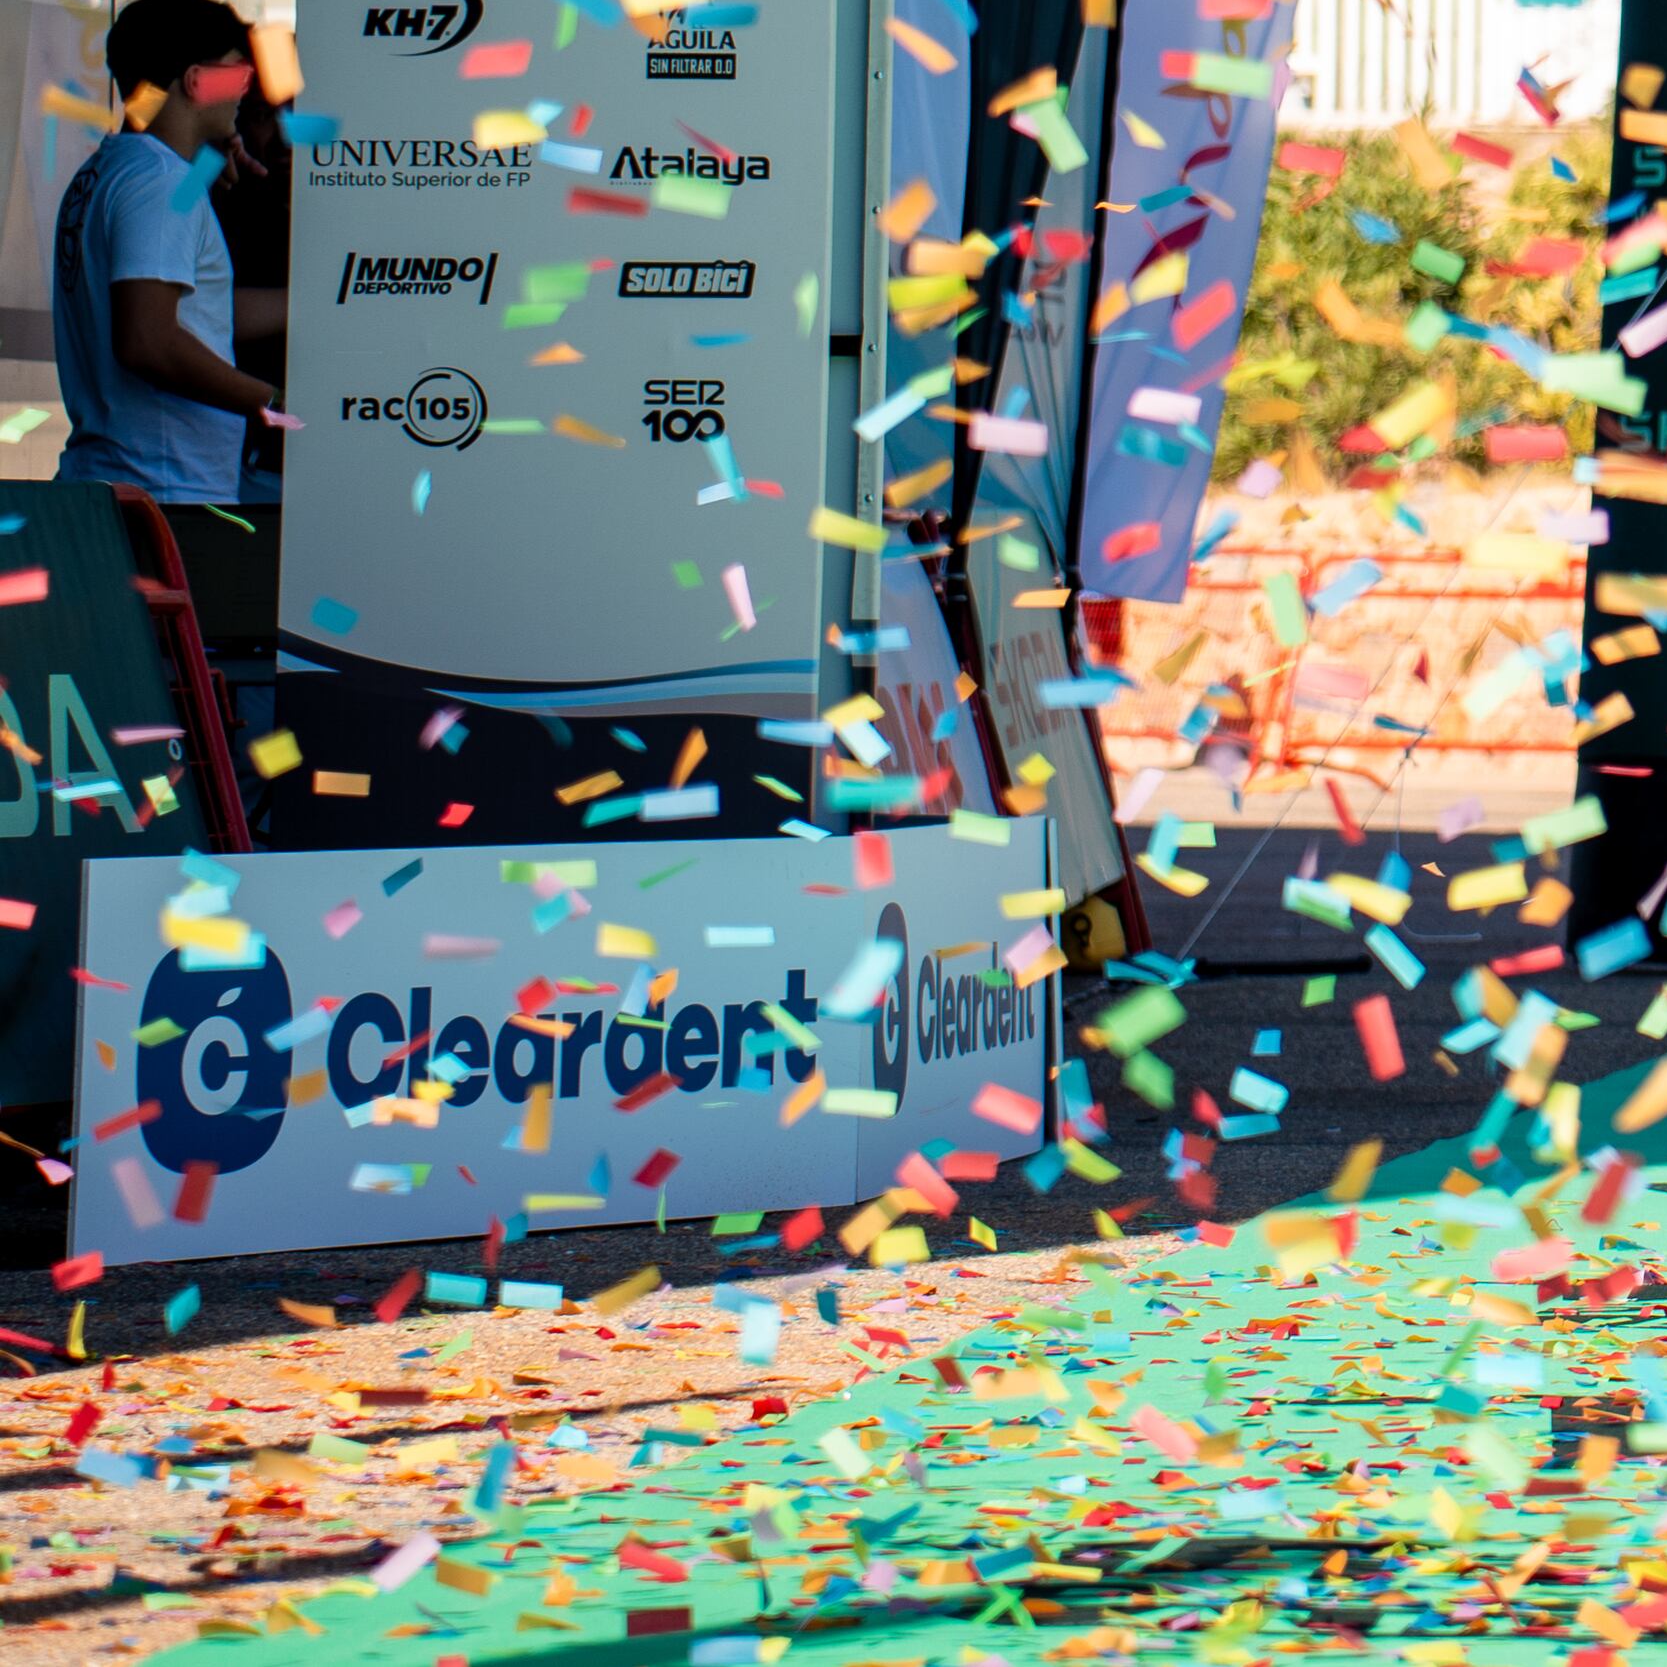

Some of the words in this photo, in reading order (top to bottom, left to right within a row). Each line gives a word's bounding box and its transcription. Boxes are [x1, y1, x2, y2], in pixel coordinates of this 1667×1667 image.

[650, 58, 669, 74] SIN
[671, 58, 713, 74] FILTRAR
[715, 58, 733, 74] 0.0
[609, 145, 771, 187] Atalaya
[309, 170, 387, 188] Instituto
[392, 170, 471, 191] Superior
[476, 170, 501, 188] de
[506, 172, 531, 188] FP
[356, 257, 484, 282] MUNDO
[627, 266, 691, 293] SOLO
[353, 281, 452, 295] DEPORTIVO
[341, 393, 405, 422] rac
[414, 395, 471, 421] 105
[642, 408, 725, 443] 100
